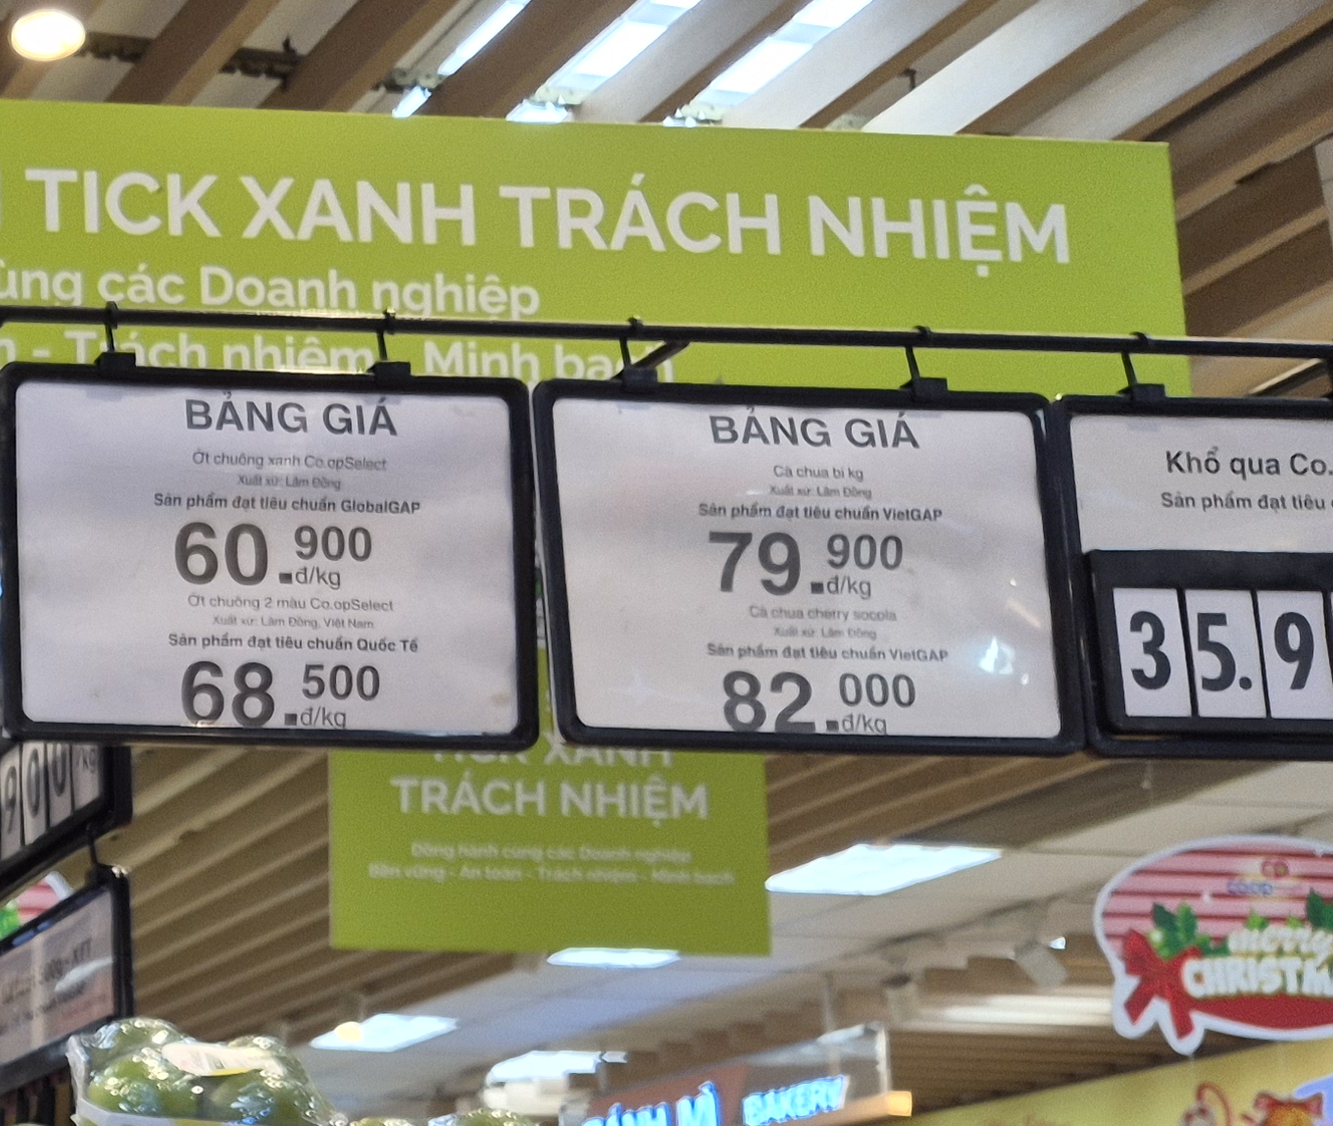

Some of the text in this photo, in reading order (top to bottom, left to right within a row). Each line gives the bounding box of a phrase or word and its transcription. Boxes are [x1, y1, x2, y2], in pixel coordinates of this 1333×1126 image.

[24, 167, 222, 239] TICK
[240, 174, 477, 246] XANH
[498, 172, 782, 255] TRÁCH
[807, 183, 1071, 278] NHIỆM
[96, 262, 185, 306] các
[199, 265, 358, 311] Doanh
[372, 273, 541, 320] nghiệp
[423, 340, 541, 384] Minh
[184, 390, 399, 437] BẢNG GIÁ
[708, 405, 920, 450] BẢNG GIÁ
[267, 453, 301, 468] xanh
[795, 465, 830, 480] chua
[847, 467, 865, 483] kg
[1165, 445, 1221, 475] Khổ
[1229, 452, 1282, 481] qua
[154, 491, 421, 515] Sản phẩm đạt tiêu chuẩn GlobalGAP
[698, 502, 727, 518] Sản
[882, 507, 944, 522] VietGAP
[1160, 490, 1327, 514] Sản phẩm đạt tiêu
[174, 521, 373, 586] 60.900
[707, 530, 904, 596] 79.900
[294, 565, 341, 590] đ/kg
[825, 576, 873, 598] đ/kg
[263, 596, 273, 609] 2
[167, 632, 198, 648] Sản
[201, 631, 243, 651] phẩm
[246, 634, 271, 652] đạt
[274, 635, 303, 651] tiêu
[306, 634, 353, 652] chuẩn
[356, 636, 396, 653] Quốc
[181, 660, 381, 727] 68.500
[721, 669, 917, 733] 82.000
[300, 706, 347, 728] đ/kg
[389, 769, 711, 828] TRÁCH NHIỆM
